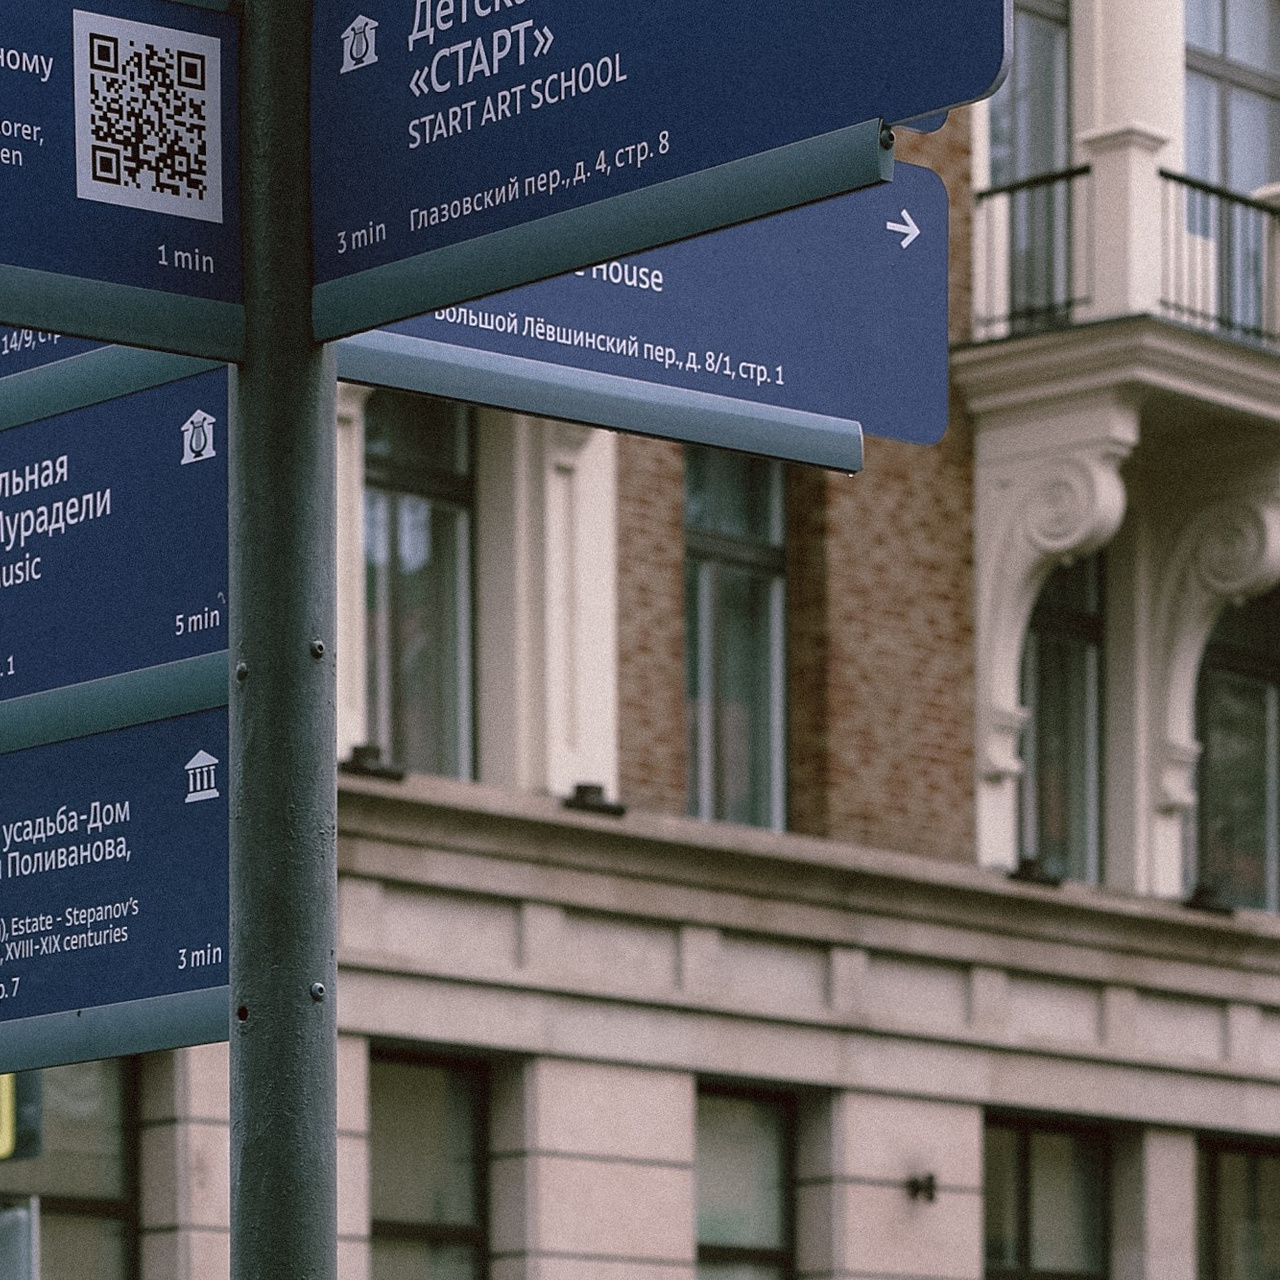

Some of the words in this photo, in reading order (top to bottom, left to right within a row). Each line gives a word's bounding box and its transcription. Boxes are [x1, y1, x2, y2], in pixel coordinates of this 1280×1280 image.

[409, 19, 554, 97] «СТАРТ»
[408, 100, 476, 149] START
[480, 84, 526, 126] ART
[530, 53, 627, 109] SCHOOL
[409, 176, 520, 232] Глазовский
[524, 169, 570, 196] пер.,
[573, 160, 591, 186] д.
[595, 150, 611, 176] 4,
[615, 141, 654, 168] стр.
[659, 130, 670, 154] 8
[337, 231, 347, 254] 3
[351, 221, 386, 250] min
[157, 244, 168, 266] 1
[174, 248, 214, 274] min
[522, 316, 639, 358] Лёвшинский
[644, 343, 683, 371] пер.,
[686, 352, 701, 373] д.
[705, 351, 735, 380] 8/1,
[739, 361, 771, 386] стр.
[775, 365, 784, 386] 1
[175, 614, 185, 636] 5
[188, 607, 220, 633] min
[7, 655, 15, 675] 1
[2, 800, 130, 852] усадьба-Дом
[7, 836, 131, 878] Поливанова,
[11, 913, 53, 937] Estate
[63, 924, 128, 951] centuries
[177, 949, 187, 970] 3
[190, 943, 222, 968] min
[12, 977, 20, 997] 7
